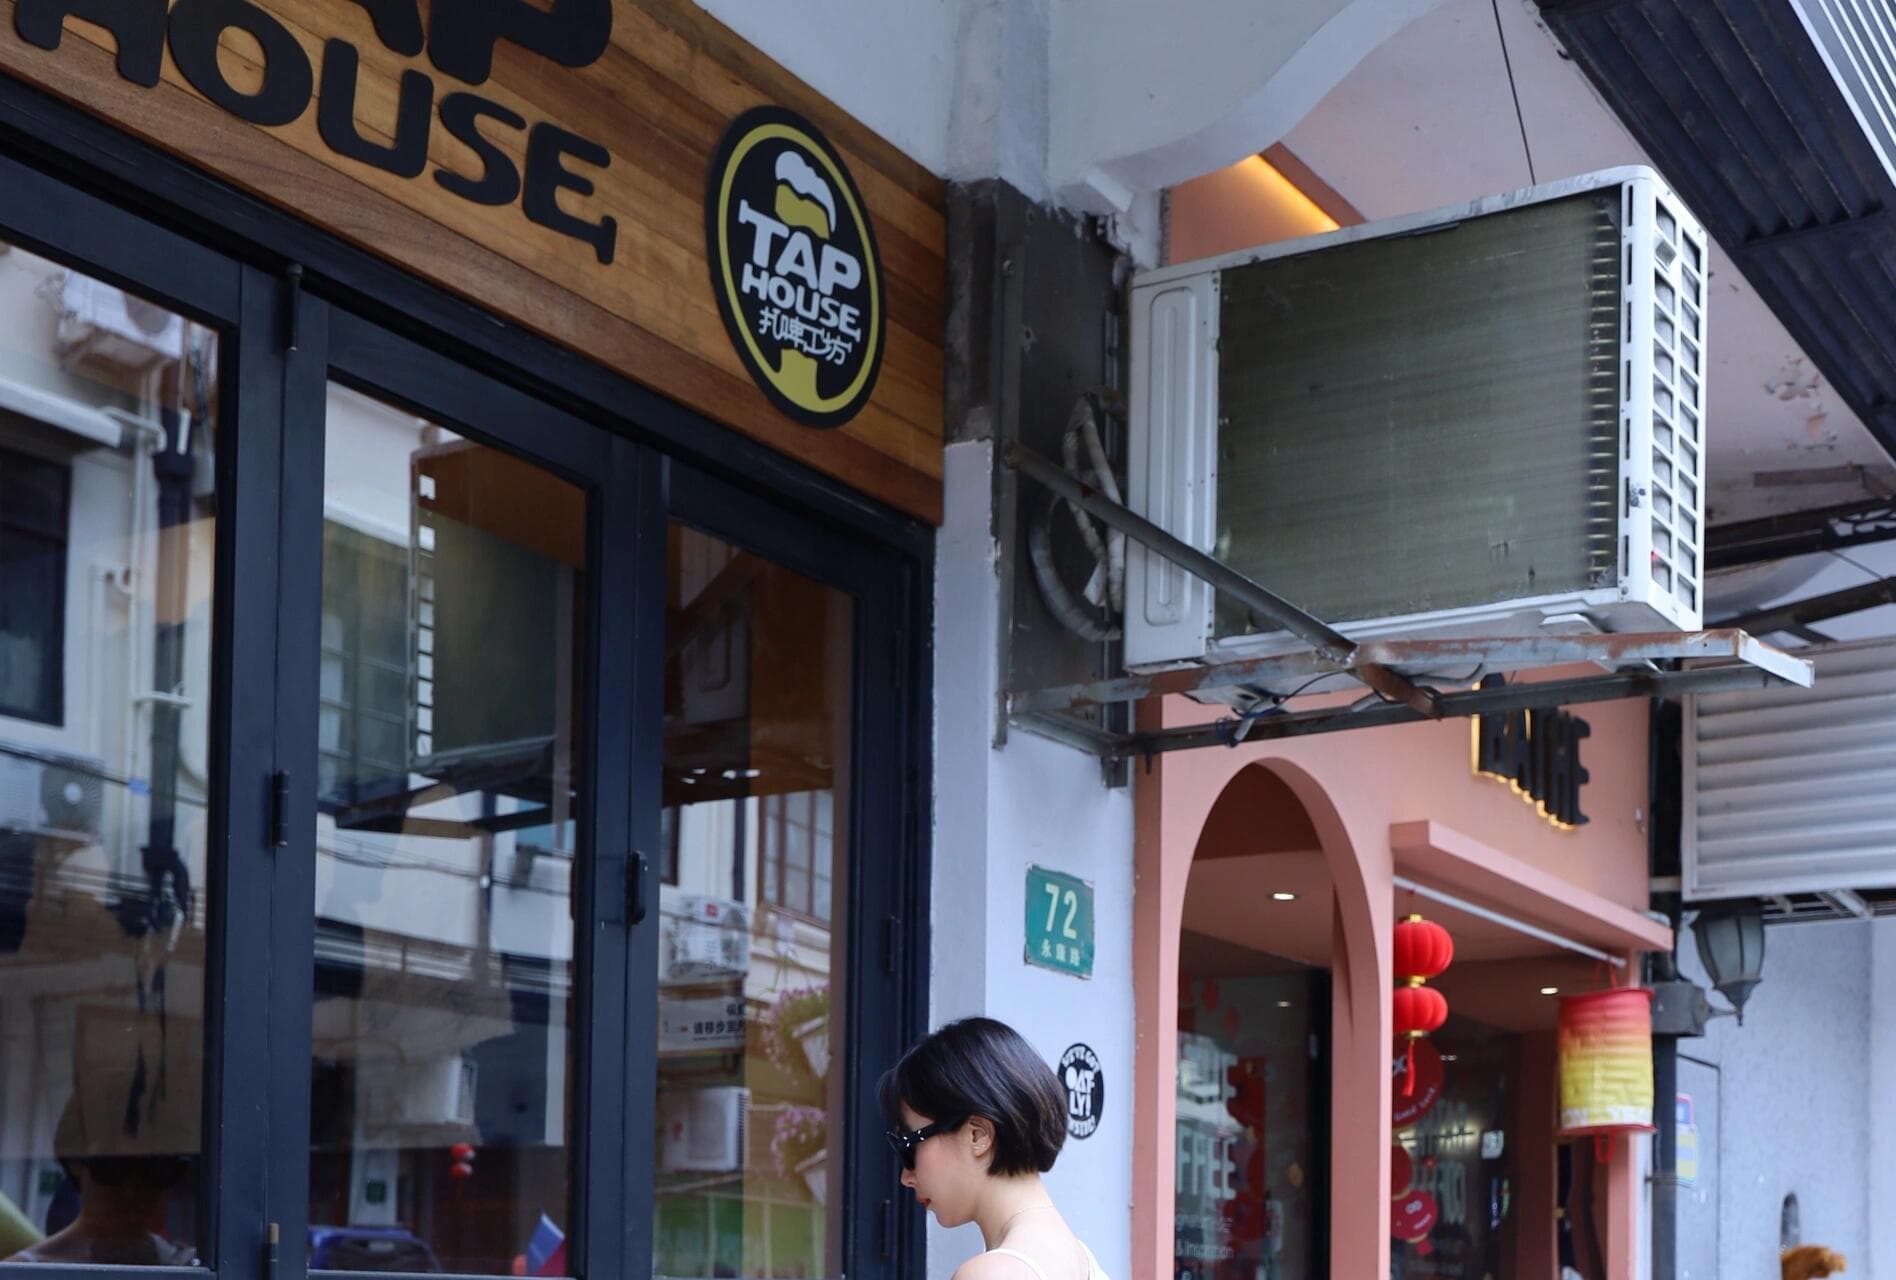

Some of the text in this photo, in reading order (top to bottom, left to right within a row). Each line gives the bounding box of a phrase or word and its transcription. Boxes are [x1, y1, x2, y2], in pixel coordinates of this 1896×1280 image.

[738, 199, 861, 296] TAP
[741, 262, 861, 342] HOUSE
[758, 306, 852, 366] 扎啤工坊
[1045, 882, 1077, 939] 72
